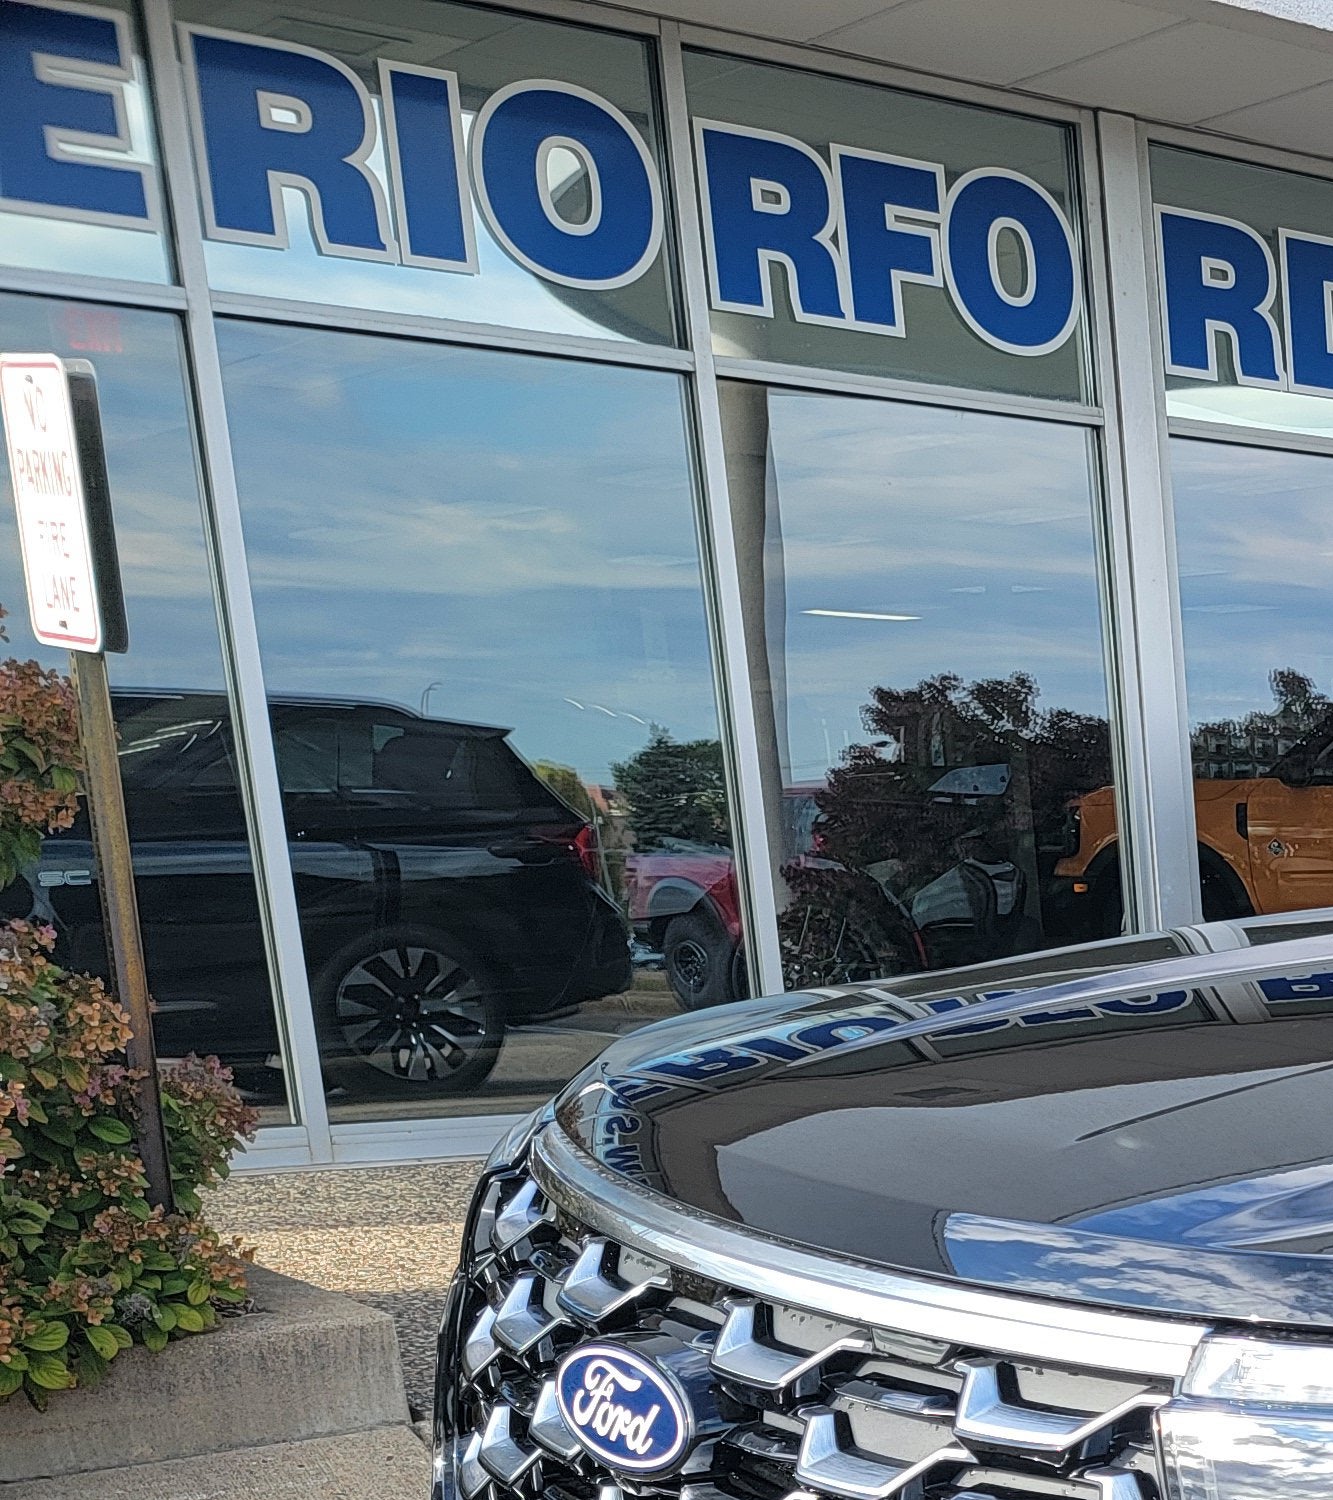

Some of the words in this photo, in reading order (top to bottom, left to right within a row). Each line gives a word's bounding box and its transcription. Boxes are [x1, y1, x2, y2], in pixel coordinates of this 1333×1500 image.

[24, 384, 47, 432] NO
[16, 449, 72, 496] PARKING
[45, 576, 80, 612] LANE
[573, 1359, 661, 1455] Ford
